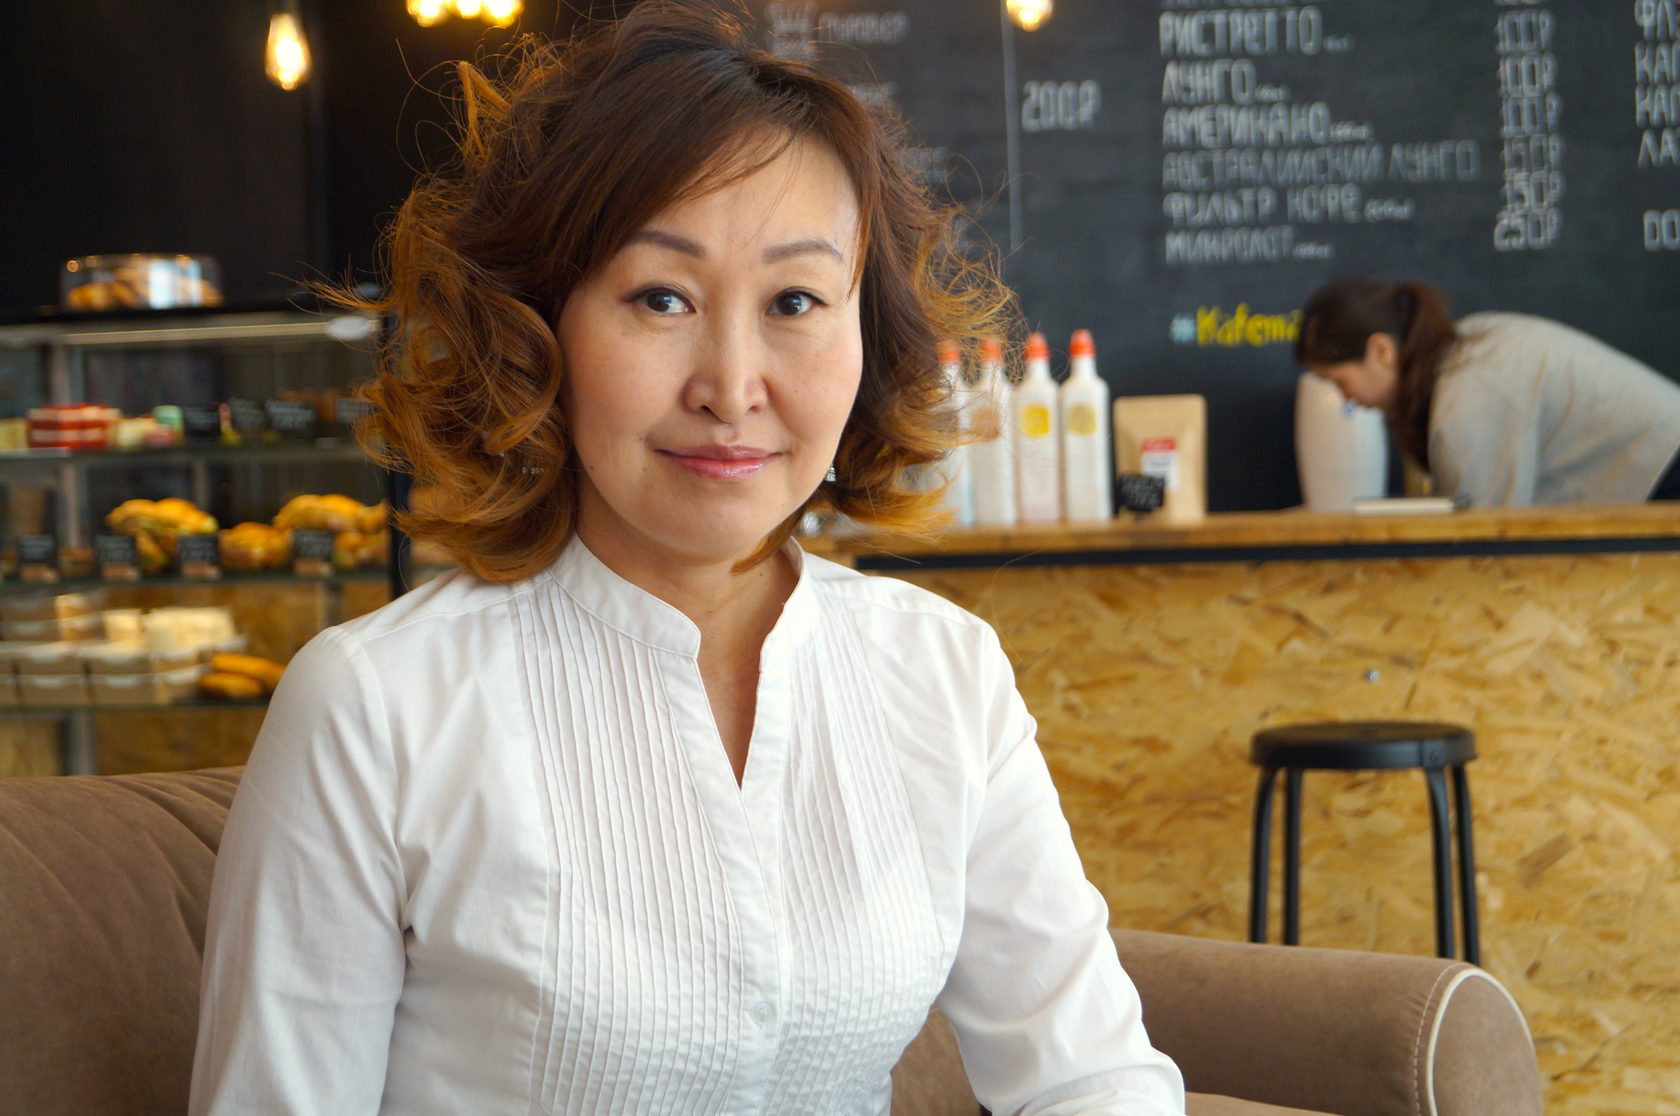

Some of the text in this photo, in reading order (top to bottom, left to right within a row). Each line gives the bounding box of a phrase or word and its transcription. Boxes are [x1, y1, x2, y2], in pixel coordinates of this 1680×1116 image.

[1159, 5, 1323, 56] РИСТРЕТТО
[1634, 0, 1680, 40] ФЛ
[1162, 58, 1256, 105] ЛУНГО
[1162, 101, 1331, 148] АМЕРИКАНО
[1388, 140, 1480, 183] ЛУНГО
[1637, 127, 1680, 168] ЛА
[1162, 186, 1278, 228] ФИЛЬТР
[1287, 183, 1362, 224] КОФЕ
[1166, 225, 1295, 266] МИКРОЛОТ
